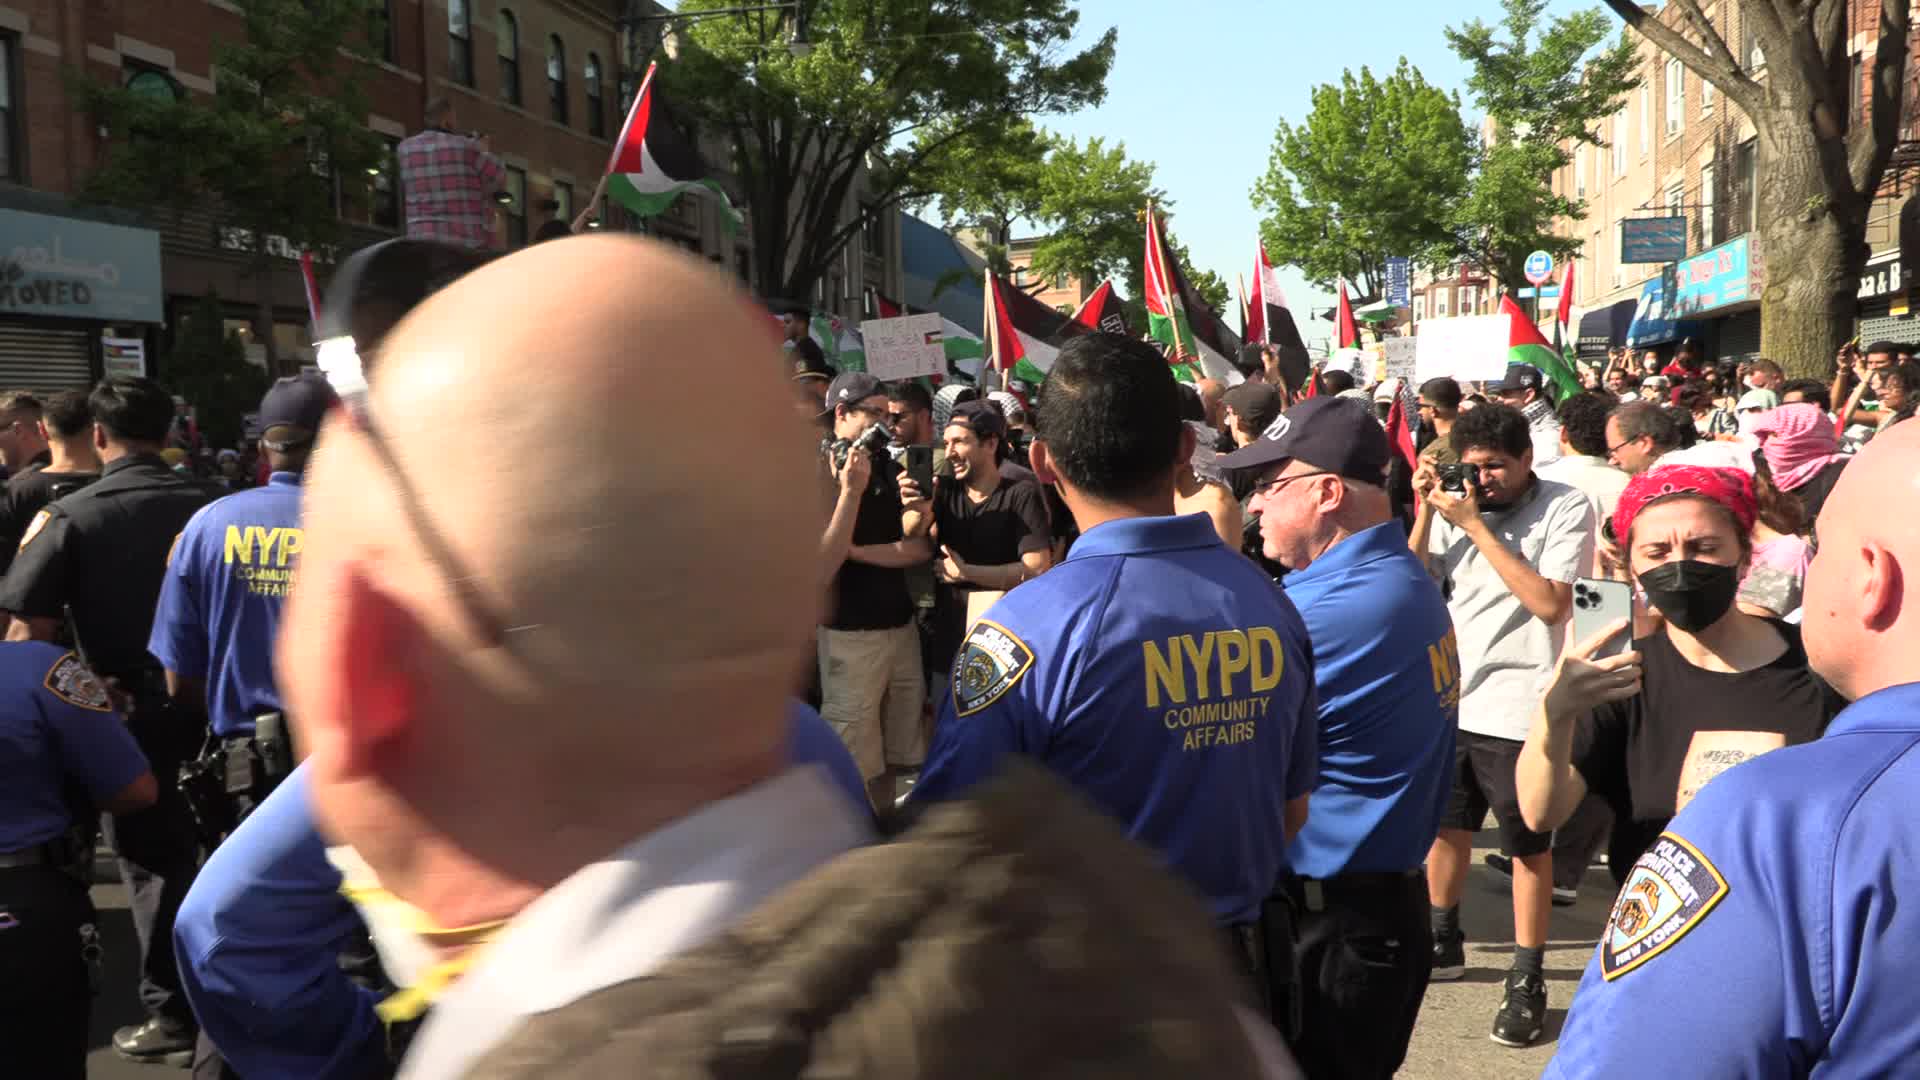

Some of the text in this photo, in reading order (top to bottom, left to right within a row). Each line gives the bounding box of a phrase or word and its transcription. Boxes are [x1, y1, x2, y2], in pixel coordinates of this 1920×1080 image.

[1263, 414, 1291, 441] PD
[224, 525, 304, 567] NYP
[1143, 626, 1284, 708] NYPD
[1165, 696, 1270, 729] COMMUNITY
[1183, 721, 1255, 752] AFFAIRS
[1654, 840, 1696, 877] POLICE
[1615, 942, 1641, 967] NEW
[1643, 914, 1686, 948] YORK
